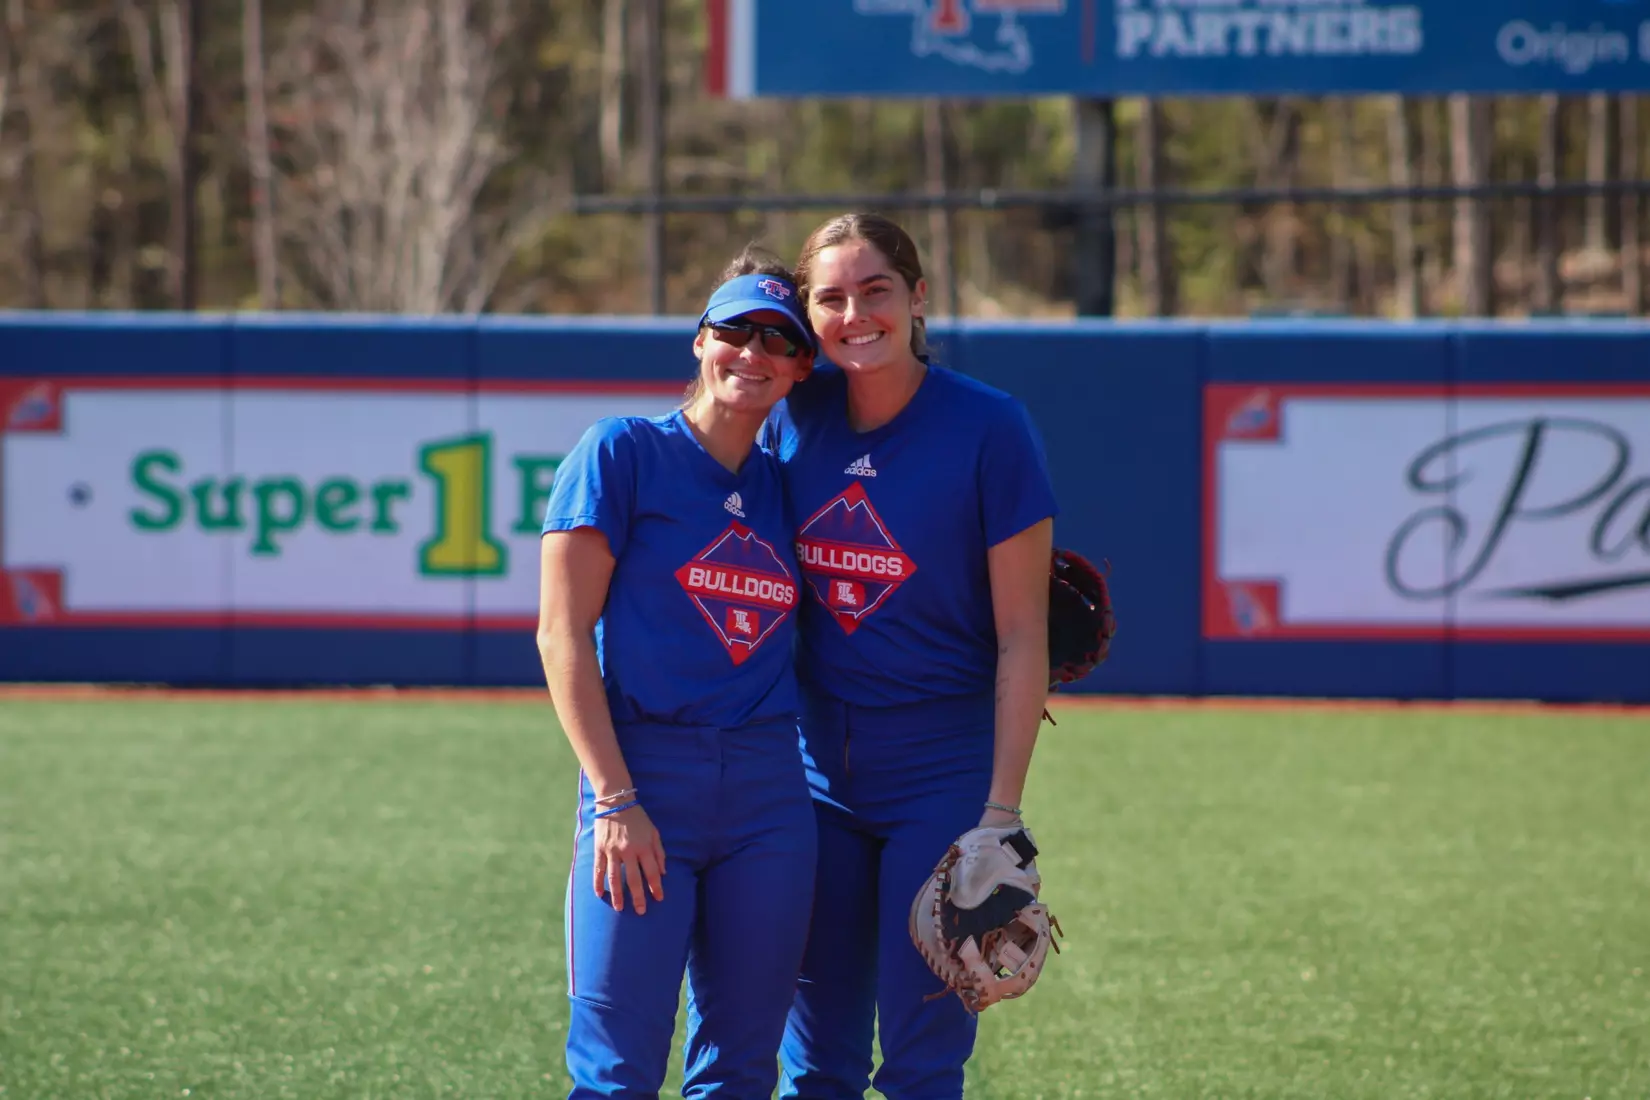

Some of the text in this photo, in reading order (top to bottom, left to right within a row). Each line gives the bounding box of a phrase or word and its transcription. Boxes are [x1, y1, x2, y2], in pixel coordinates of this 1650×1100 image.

[1116, 8, 1422, 56] PARTNERS
[1496, 19, 1629, 74] Origin
[844, 464, 877, 477] adidas
[128, 448, 412, 556] Super
[417, 430, 508, 577] 1
[796, 542, 903, 576] BULLDOGS
[688, 567, 795, 605] BULLDOGS
